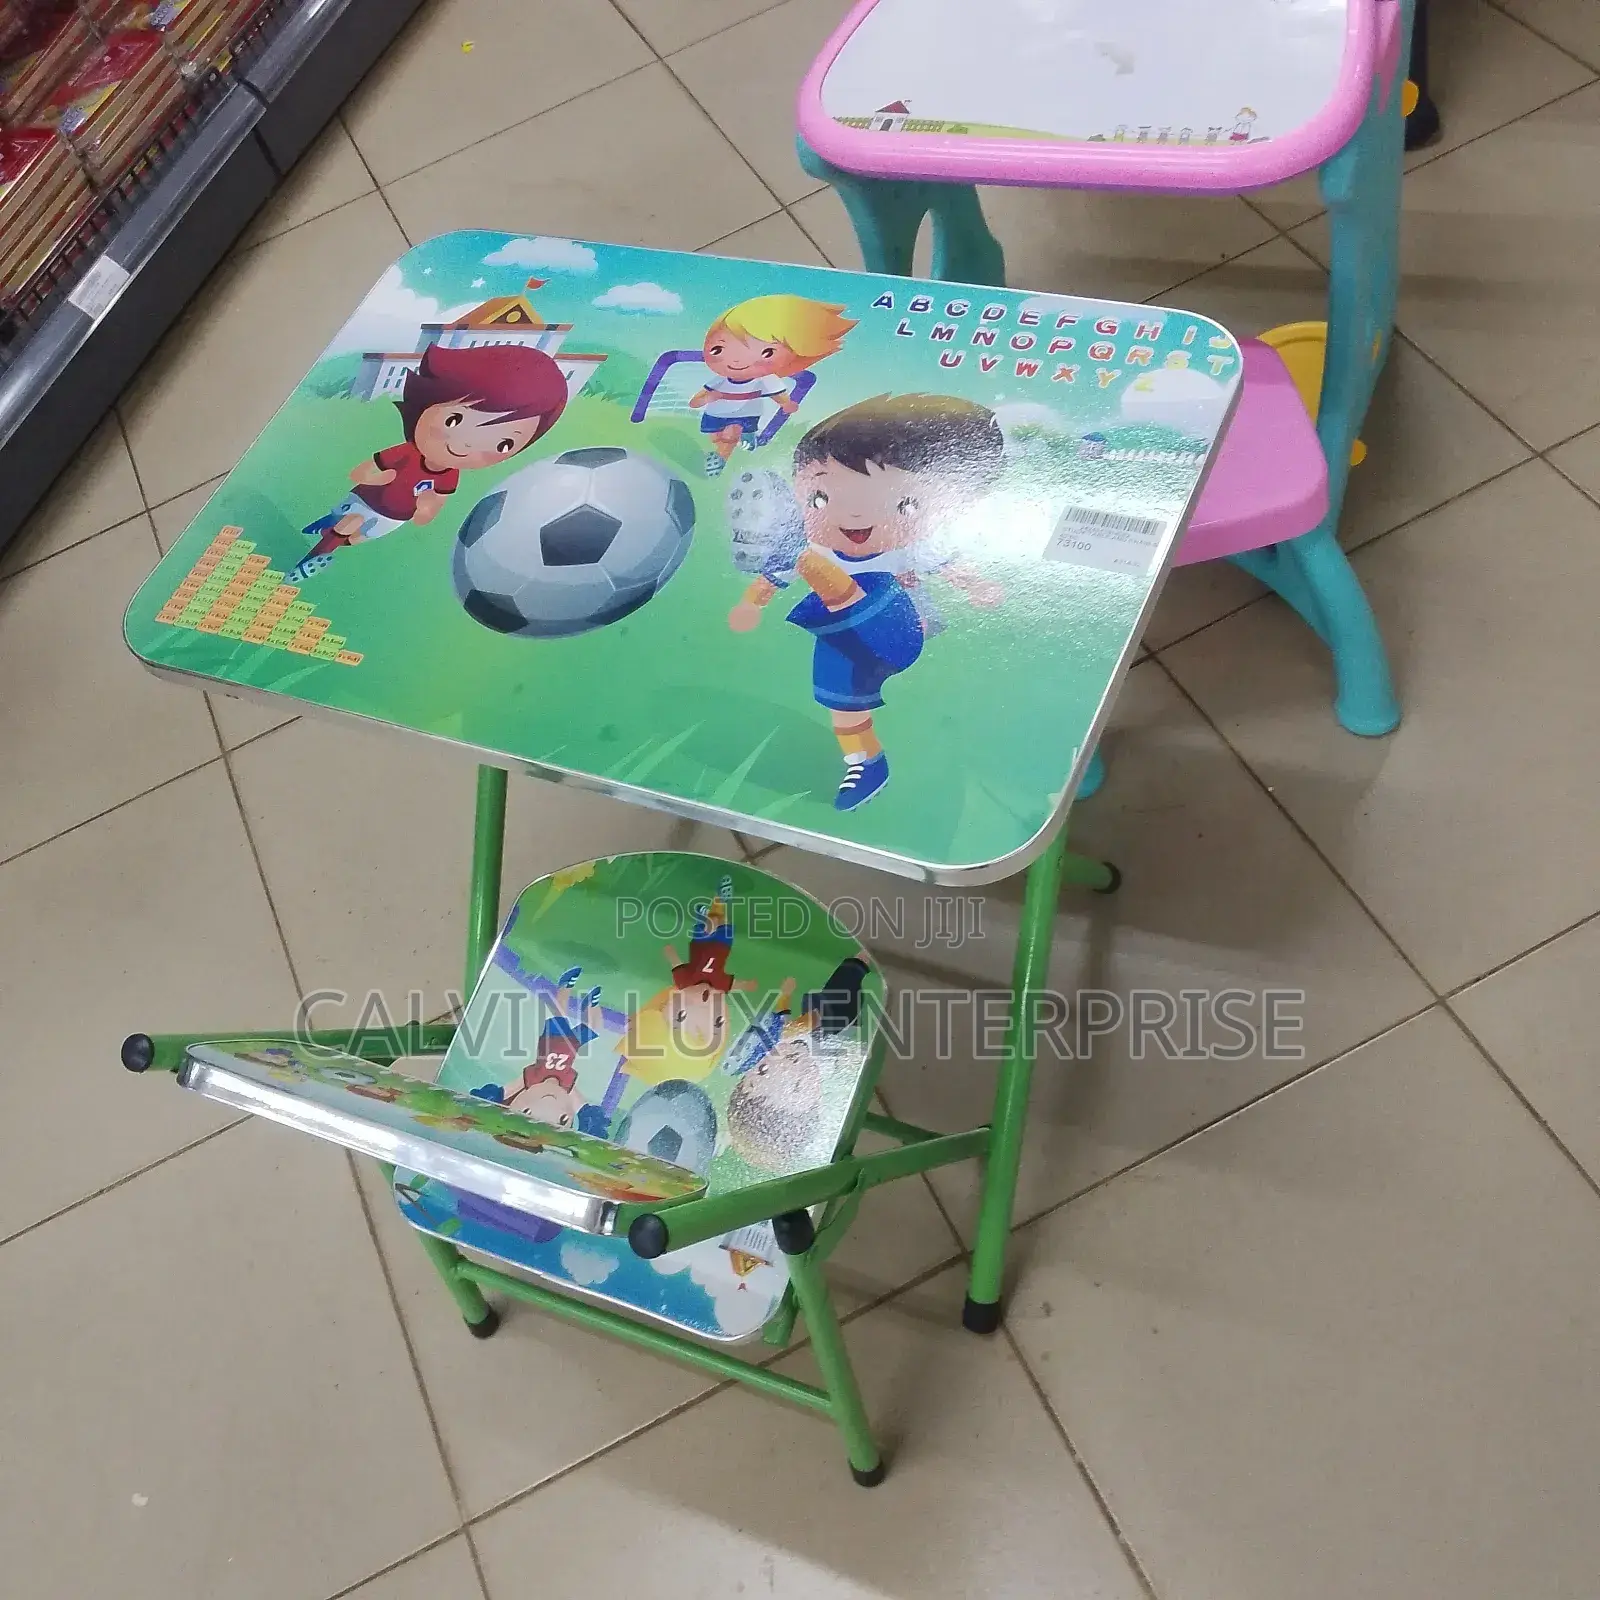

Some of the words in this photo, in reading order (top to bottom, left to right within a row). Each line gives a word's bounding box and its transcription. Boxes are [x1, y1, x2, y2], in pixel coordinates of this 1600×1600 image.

[871, 291, 893, 310] A
[908, 295, 933, 313] B
[944, 299, 970, 318] C
[981, 303, 1006, 322] D
[1017, 308, 1041, 327] E
[1055, 312, 1080, 330] F
[1094, 317, 1120, 336] G
[1134, 320, 1164, 341] H
[1182, 325, 1198, 345] I
[896, 318, 915, 337] L
[930, 322, 956, 342] M
[971, 326, 999, 347] N
[1009, 331, 1038, 351] O
[1048, 337, 1075, 355] P
[1087, 340, 1116, 362] Q
[1125, 345, 1154, 366] R
[1165, 350, 1192, 370] S
[1207, 354, 1235, 376] T
[939, 349, 964, 369] U
[979, 353, 1002, 373] V
[1014, 357, 1042, 378] W
[1051, 363, 1080, 383] X
[1096, 368, 1122, 389] Y
[702, 957, 715, 973] 7
[545, 1053, 570, 1071] 23
